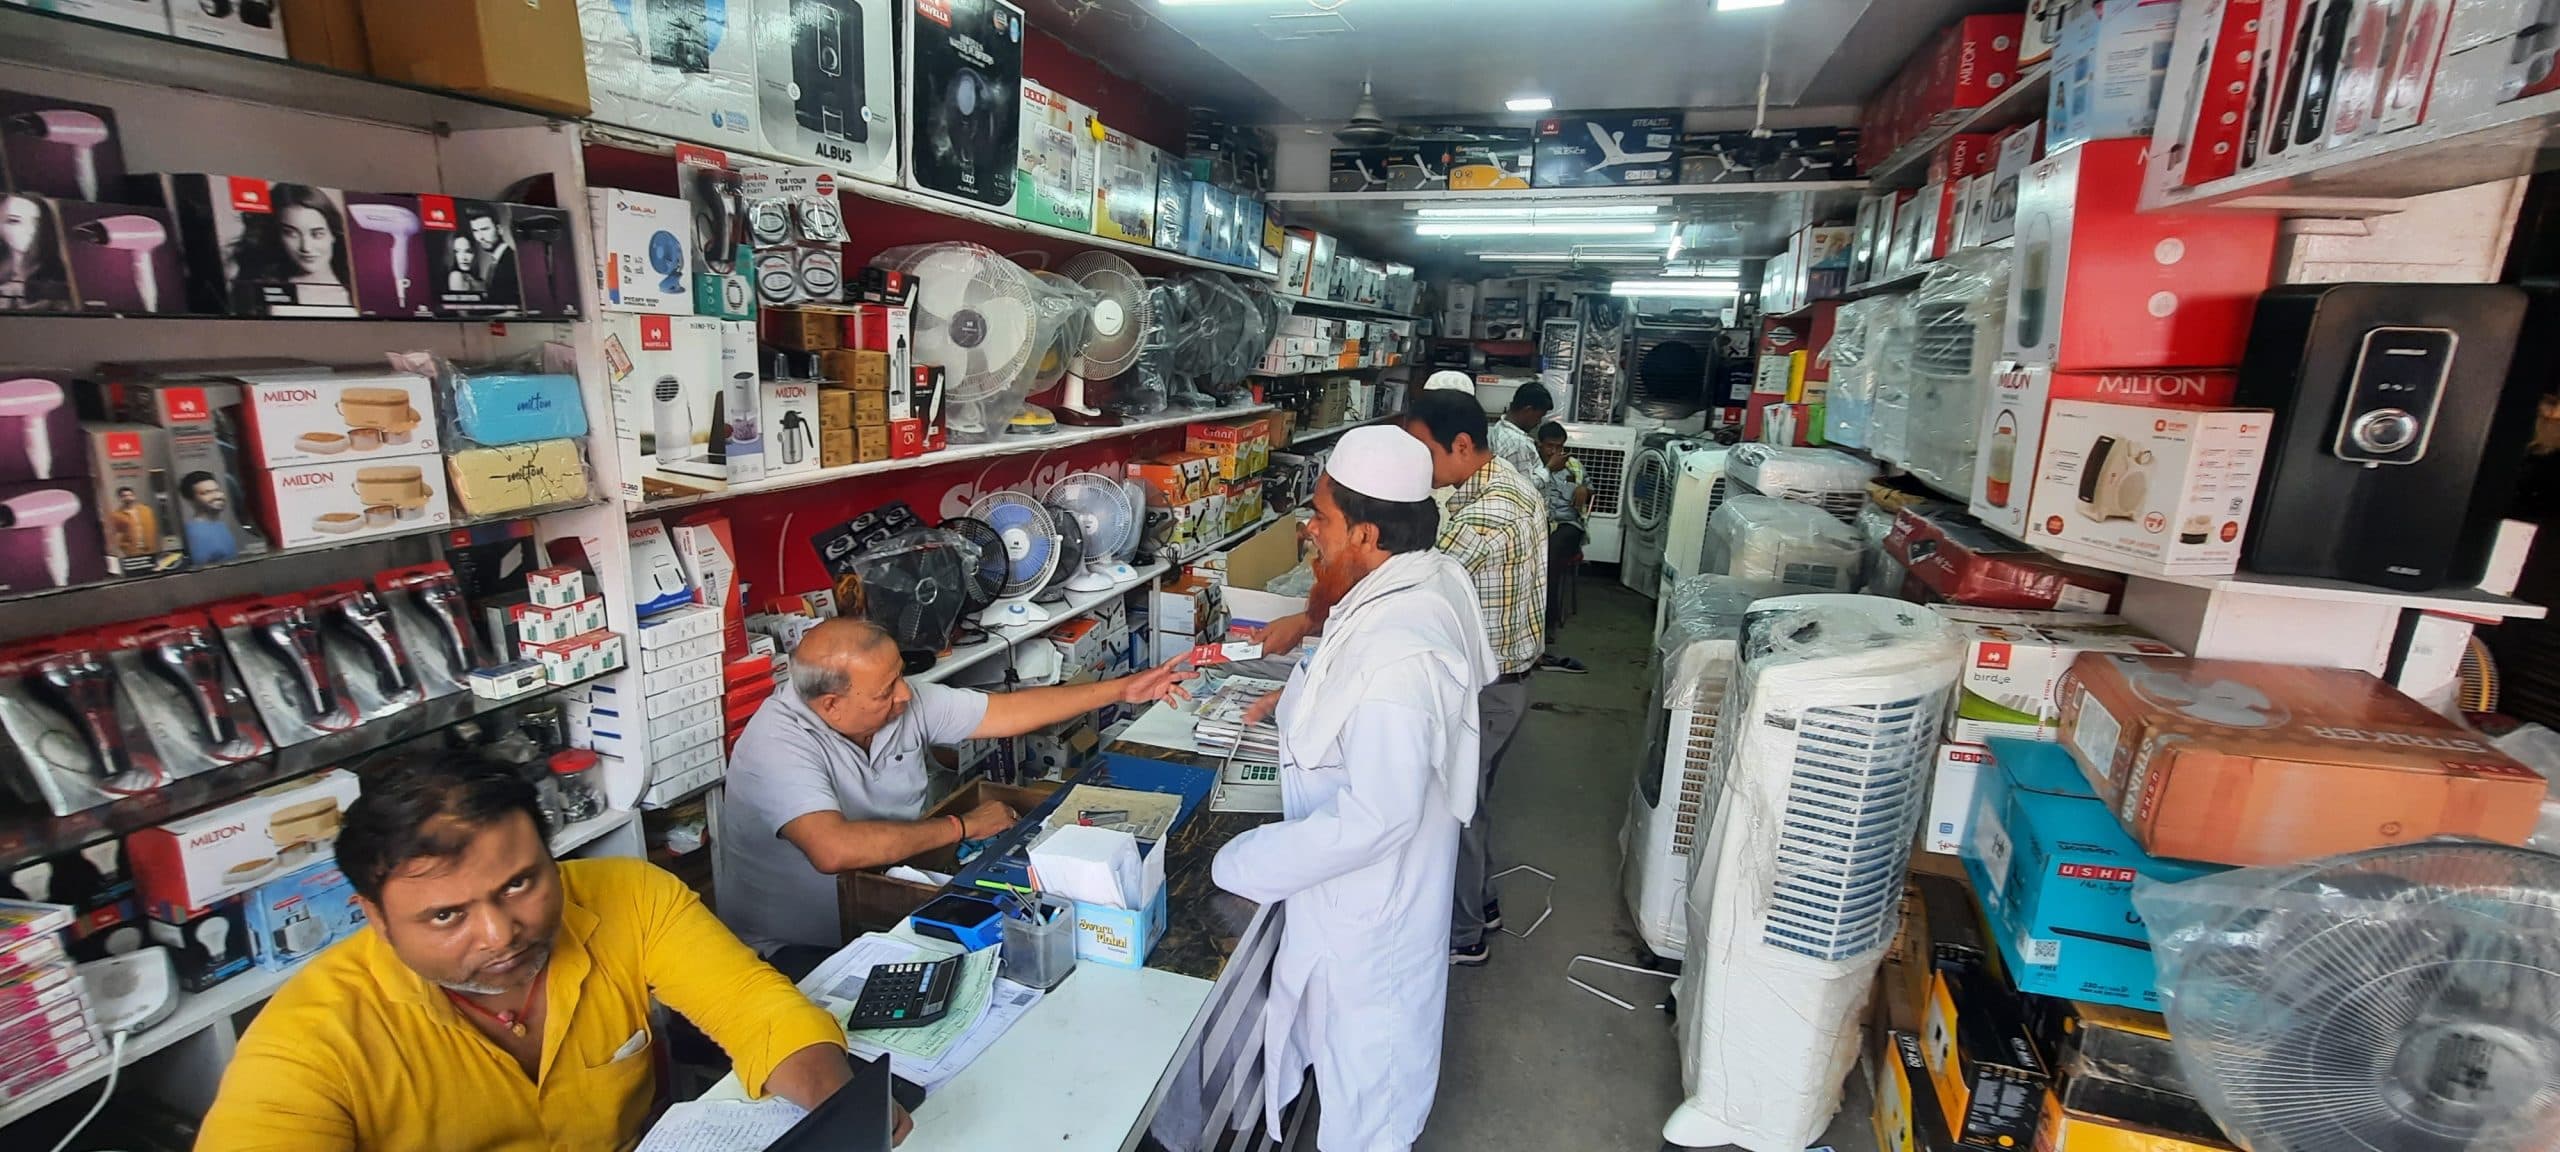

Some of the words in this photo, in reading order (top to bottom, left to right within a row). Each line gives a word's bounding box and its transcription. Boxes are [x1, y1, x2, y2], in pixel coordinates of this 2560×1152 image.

[918, 2, 949, 22] HAVELLS
[1959, 41, 1977, 86] MILTON
[815, 142, 852, 163] ALBUS
[776, 178, 788, 186] FOR
[789, 177, 807, 186] YOUR
[780, 184, 803, 192] SAFETY
[630, 205, 656, 214] BAJAJ
[775, 387, 807, 399] MILTON
[2097, 375, 2206, 395] MILTON
[263, 389, 317, 403] MILTON
[517, 392, 551, 411] milton
[282, 472, 334, 487] MILTON
[507, 460, 544, 482] milton
[2304, 726, 2488, 753] STRIKER
[2121, 738, 2154, 822] STRIKER
[2141, 772, 2160, 820] USHA
[190, 823, 246, 849] MILTON
[2061, 865, 2133, 881] USHA
[1097, 933, 1127, 948] Mahal
